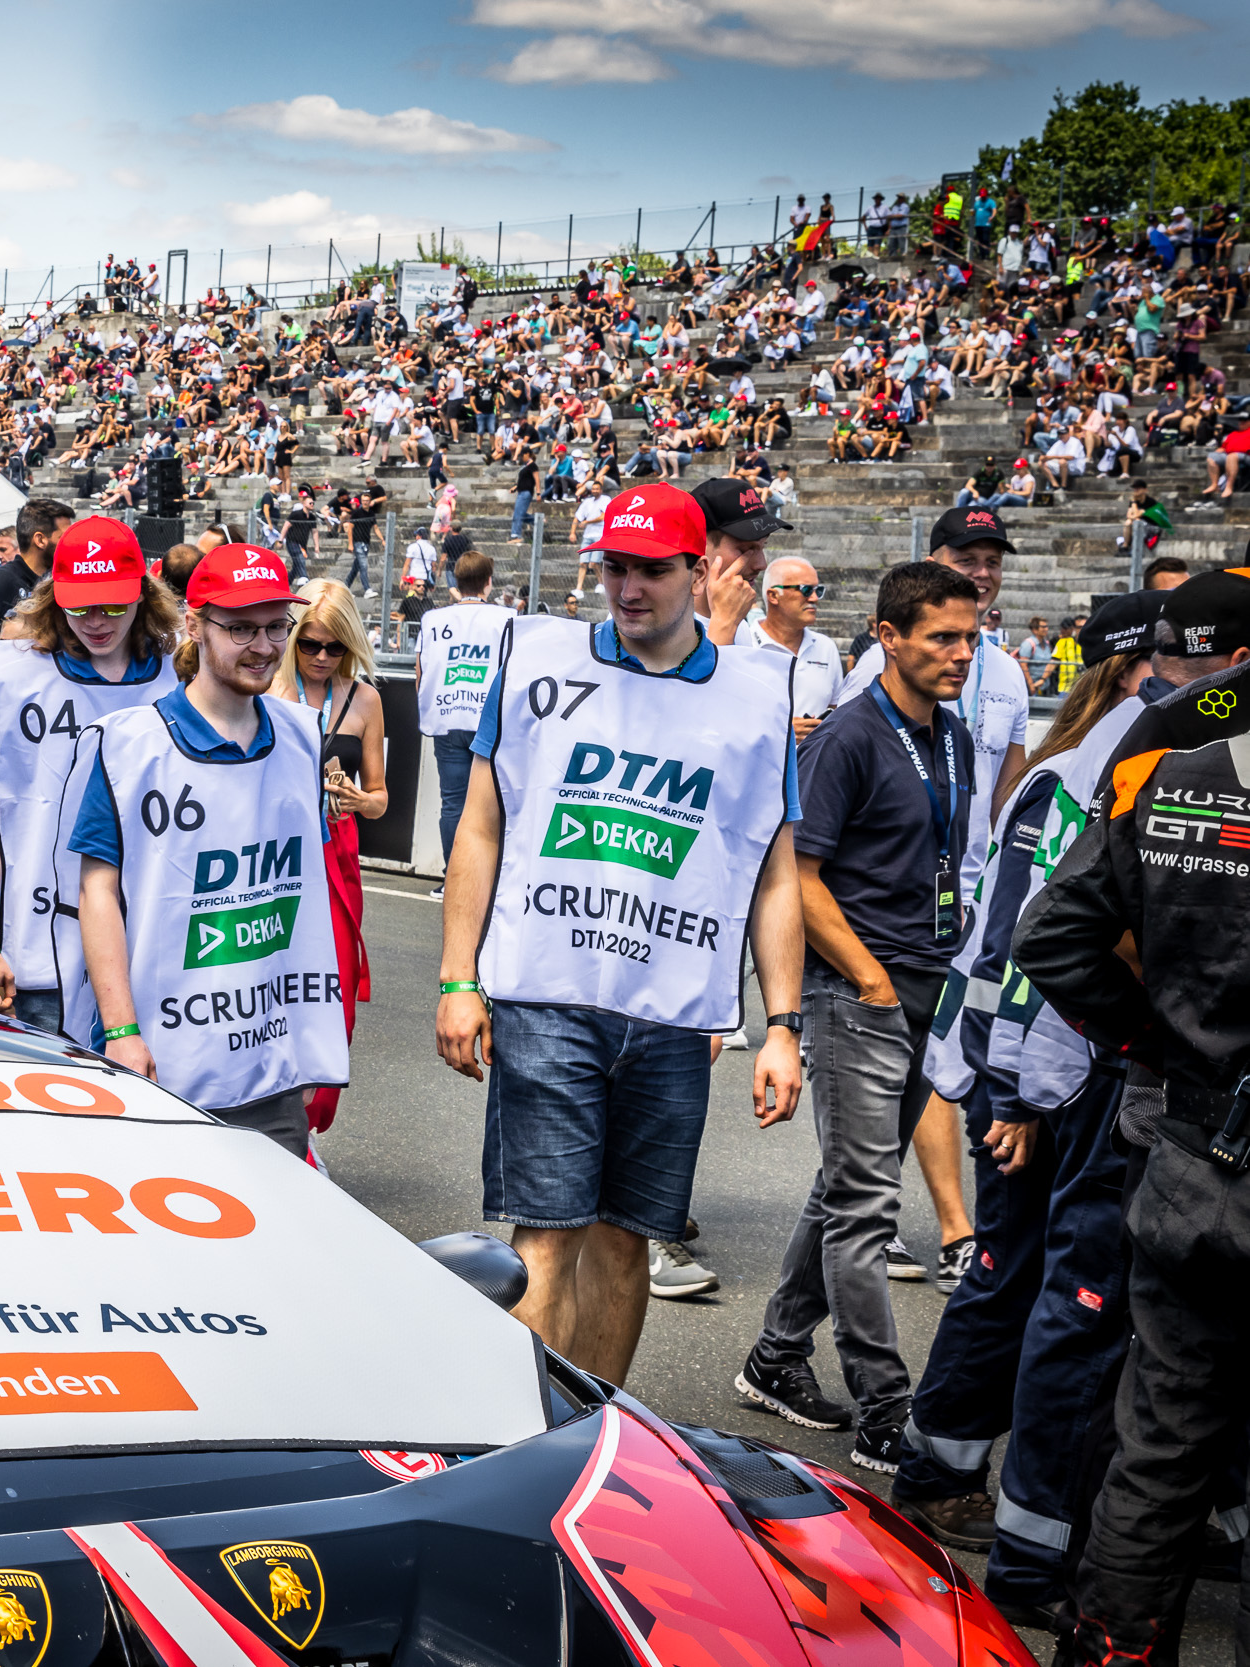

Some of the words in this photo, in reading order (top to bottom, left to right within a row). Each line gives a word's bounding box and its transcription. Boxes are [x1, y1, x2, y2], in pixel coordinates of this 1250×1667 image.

[610, 514, 655, 531] DEKRA
[73, 560, 116, 575] DEKRA
[233, 567, 279, 583] DEKRA
[431, 624, 453, 641] 16
[1104, 623, 1147, 641] marshal
[1184, 625, 1216, 636] READY
[1185, 636, 1199, 644] TO
[448, 643, 490, 660] DTM
[1114, 637, 1139, 650] 2021
[1187, 643, 1213, 654] RACE
[528, 676, 601, 721] 07
[20, 699, 81, 744] 04
[896, 728, 929, 780] DTM.COM
[563, 742, 715, 811] DTM
[141, 783, 205, 837] 06
[558, 789, 600, 800] OFFICIAL
[602, 792, 660, 813] TECHNICAL
[659, 806, 704, 825] PARTNER
[592, 820, 674, 863] DEKRA
[193, 836, 302, 894] DTM
[191, 896, 237, 909] OFFICIAL
[235, 912, 285, 948] DEKRA
[604, 932, 652, 964] 2022
[229, 1029, 263, 1052] DTM
[99, 1303, 268, 1337] Autos
[228, 1545, 309, 1567] LAMBORGHINI
